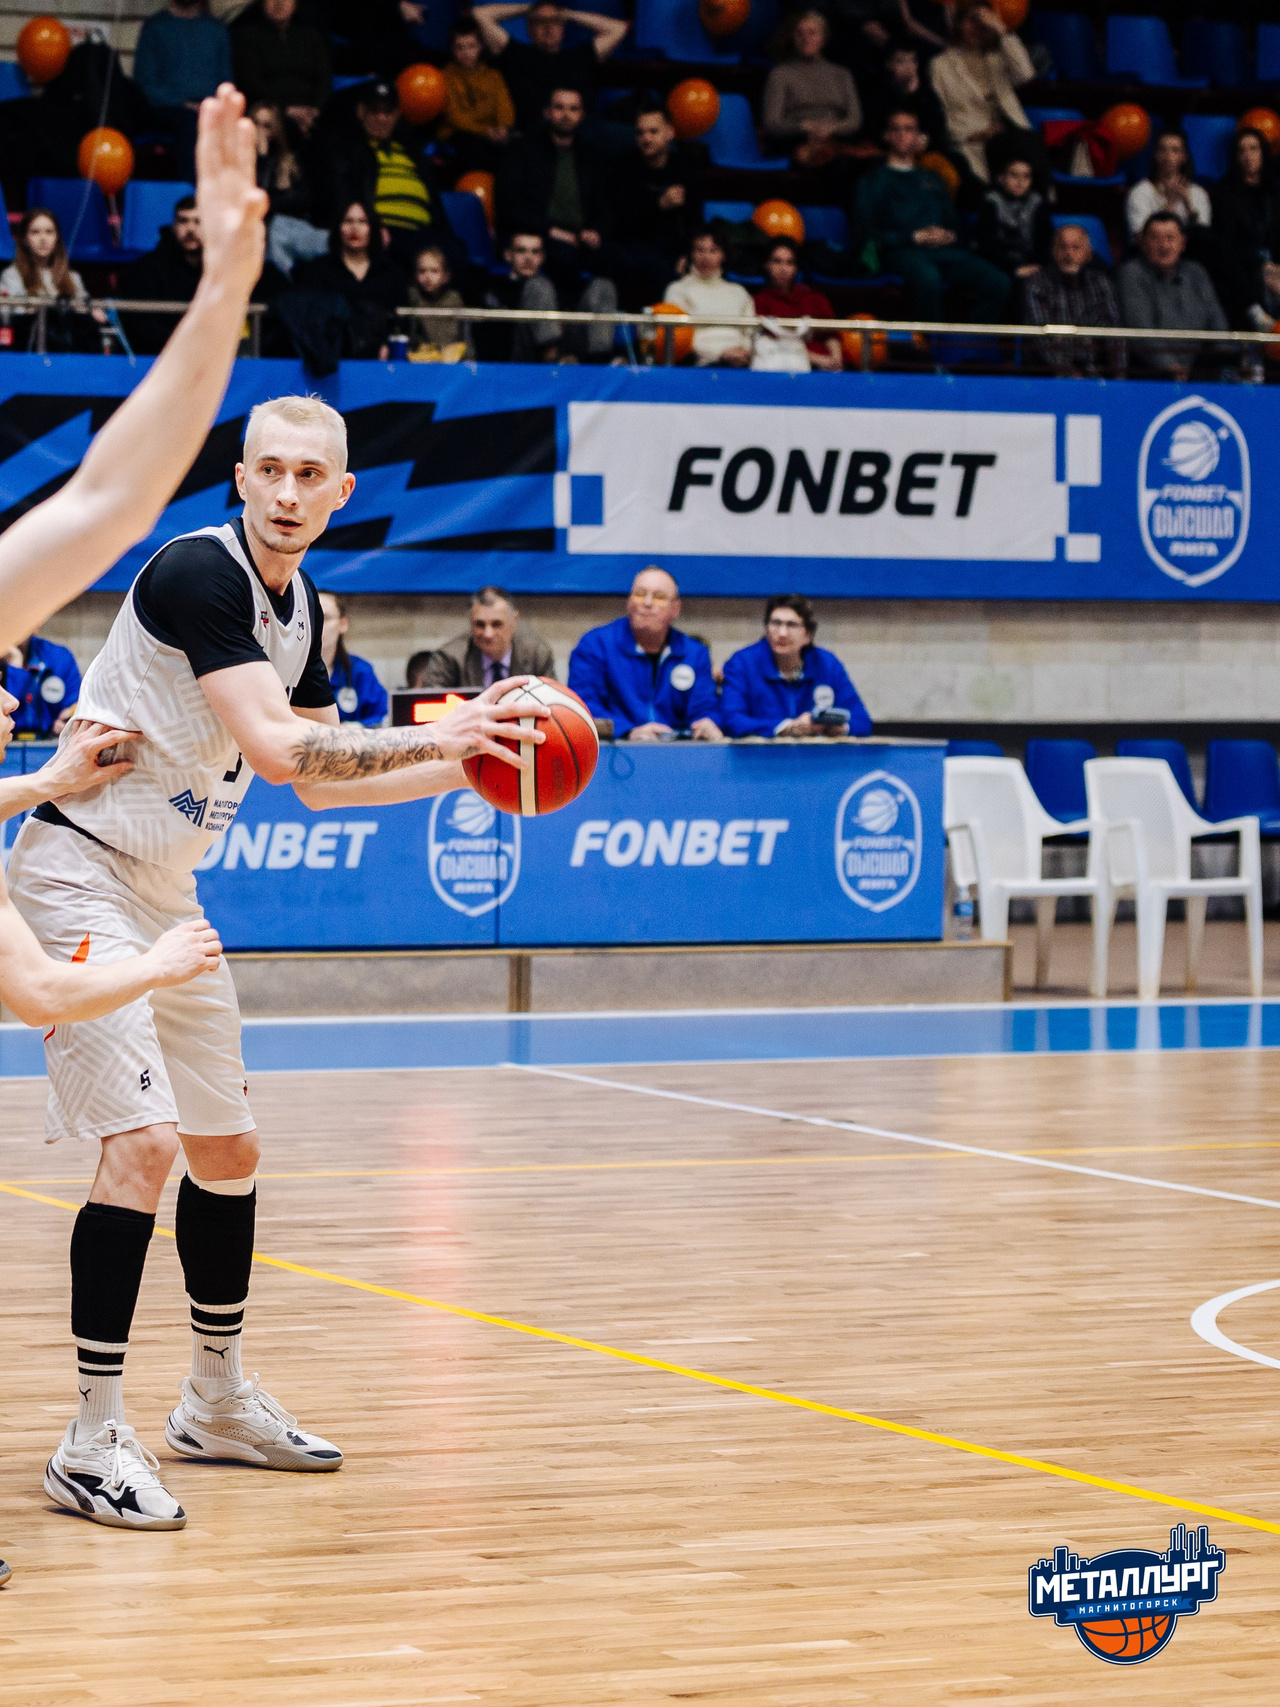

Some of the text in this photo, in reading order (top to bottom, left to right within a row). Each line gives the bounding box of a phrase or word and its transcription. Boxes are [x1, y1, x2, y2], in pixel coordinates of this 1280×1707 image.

[667, 445, 997, 519] FONBET
[1160, 484, 1228, 503] FONBET
[1152, 504, 1235, 540] ВЫСШАЯ
[570, 818, 790, 868] FONBET
[140, 1068, 152, 1092] 5
